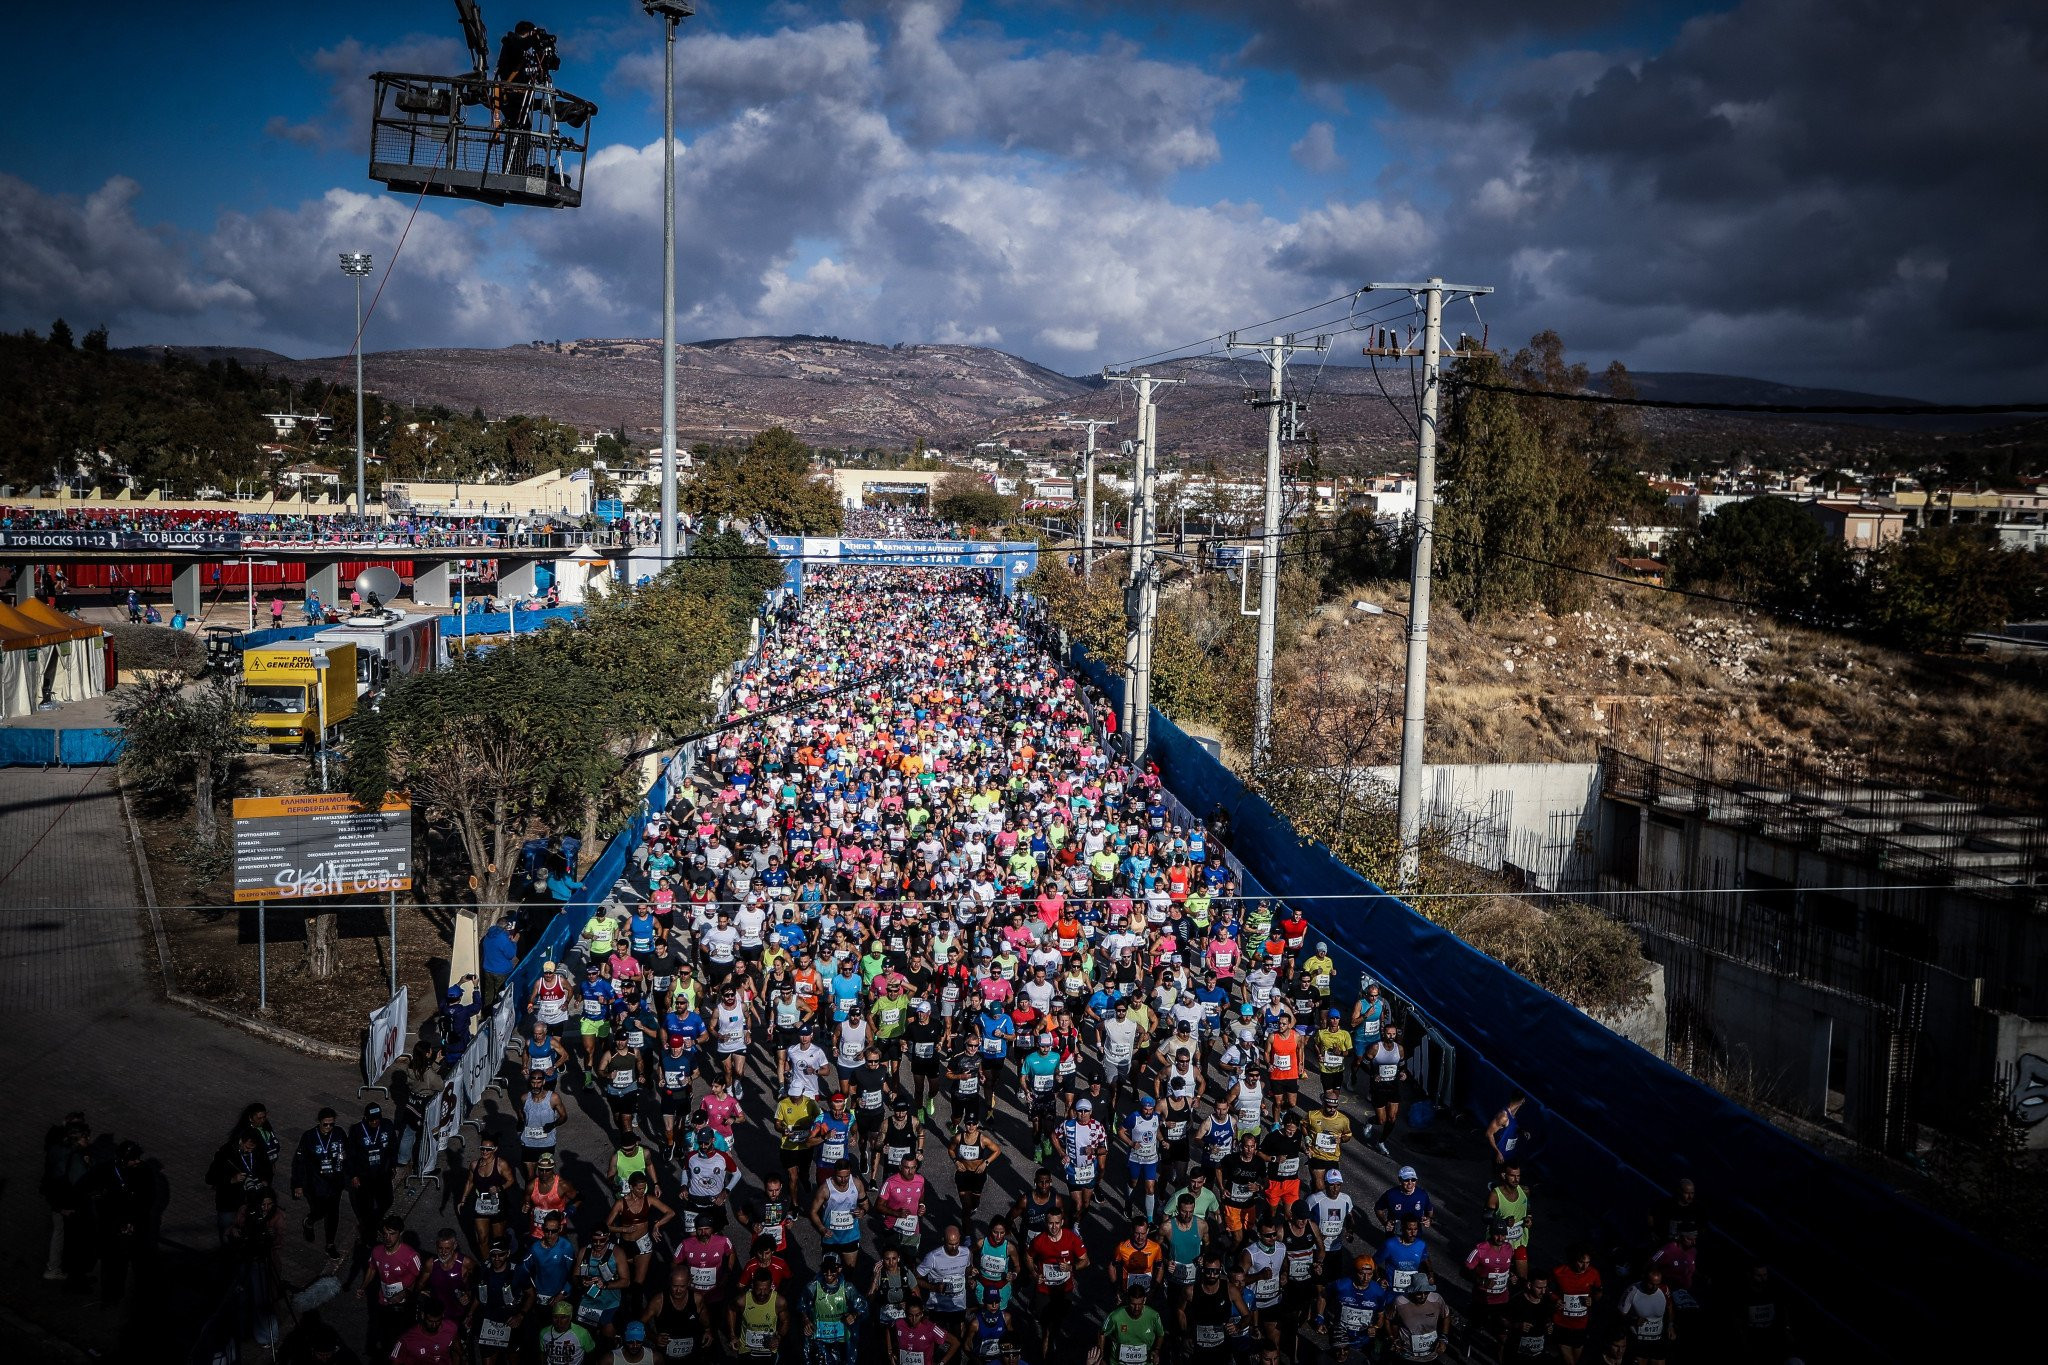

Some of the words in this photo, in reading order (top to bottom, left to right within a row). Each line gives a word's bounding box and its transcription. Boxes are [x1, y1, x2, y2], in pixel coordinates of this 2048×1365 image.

[12, 536, 26, 546] TO
[31, 535, 73, 546] BLOCKS
[76, 536, 106, 546] 11-12
[143, 533, 158, 543] TO
[161, 533, 205, 543] BLOCKS
[209, 534, 225, 543] 1-6
[281, 798, 318, 806] ΕΛΛΗΝΙΚΗ
[487, 1329, 505, 1337] 6019
